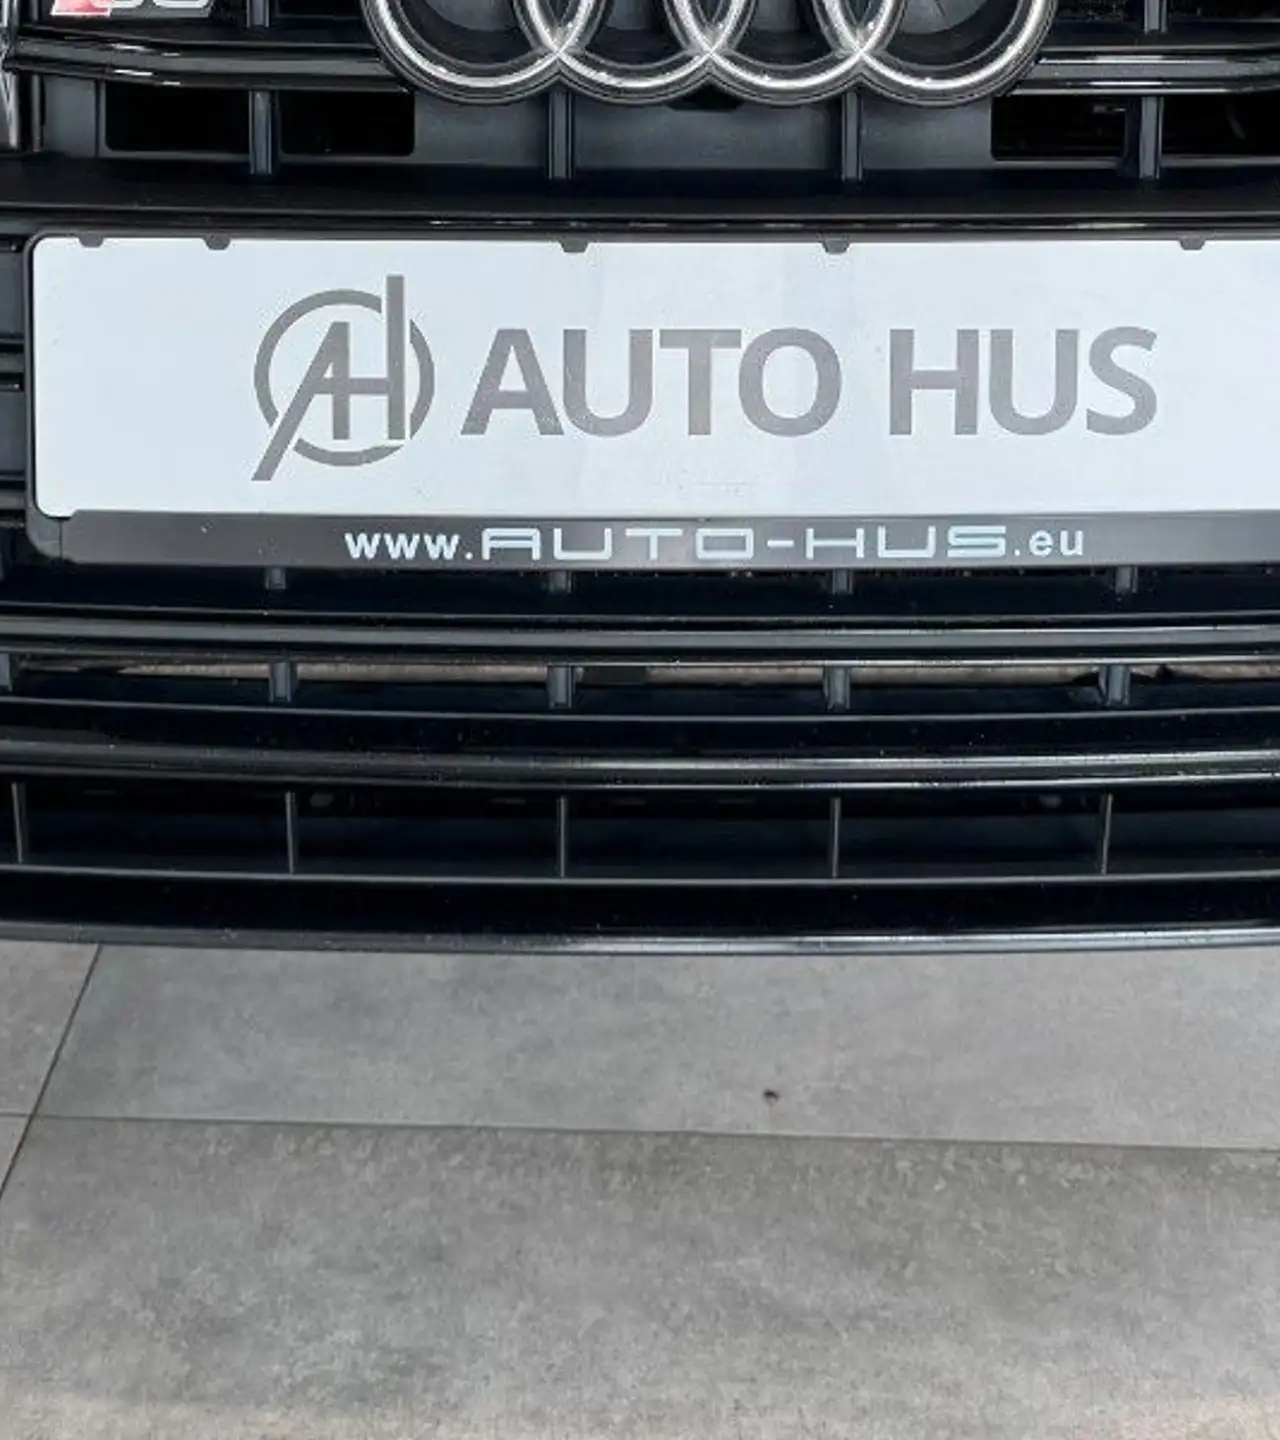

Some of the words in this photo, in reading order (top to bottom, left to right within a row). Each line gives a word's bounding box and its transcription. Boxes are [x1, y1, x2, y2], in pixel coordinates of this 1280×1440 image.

[460, 327, 842, 437] AUTO
[889, 326, 1158, 437] HUS
[344, 525, 1085, 562] www.AUTO-HUS.eu
